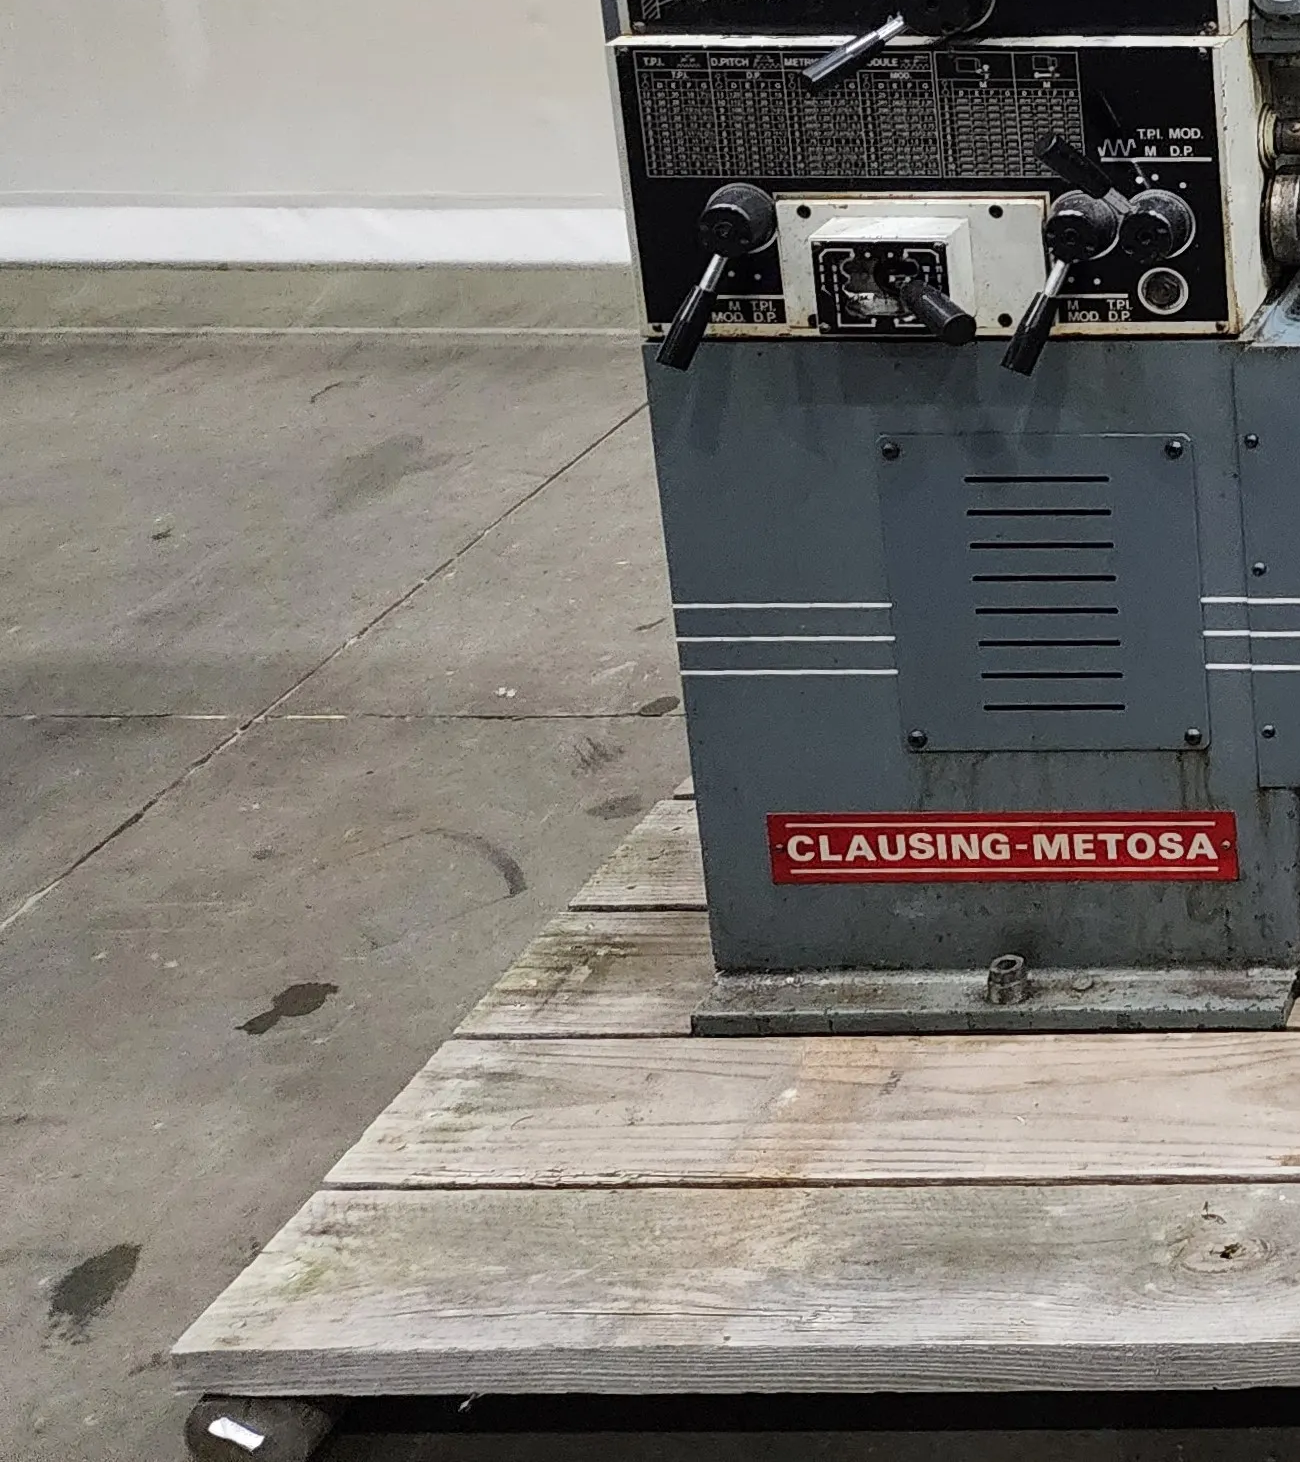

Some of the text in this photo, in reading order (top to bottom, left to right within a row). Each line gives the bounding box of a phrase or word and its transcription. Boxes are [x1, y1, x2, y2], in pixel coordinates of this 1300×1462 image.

[711, 57, 749, 67] D.PITCH
[1136, 127, 1204, 140] T.P.I. MOD.
[1144, 145, 1194, 157] M D.P.
[728, 300, 741, 311] M
[1067, 299, 1079, 310] M
[711, 311, 777, 323] MOD. D.P.
[1067, 310, 1132, 322] MOD. D.P.
[787, 832, 1218, 861] CLAUSING-METOSA
